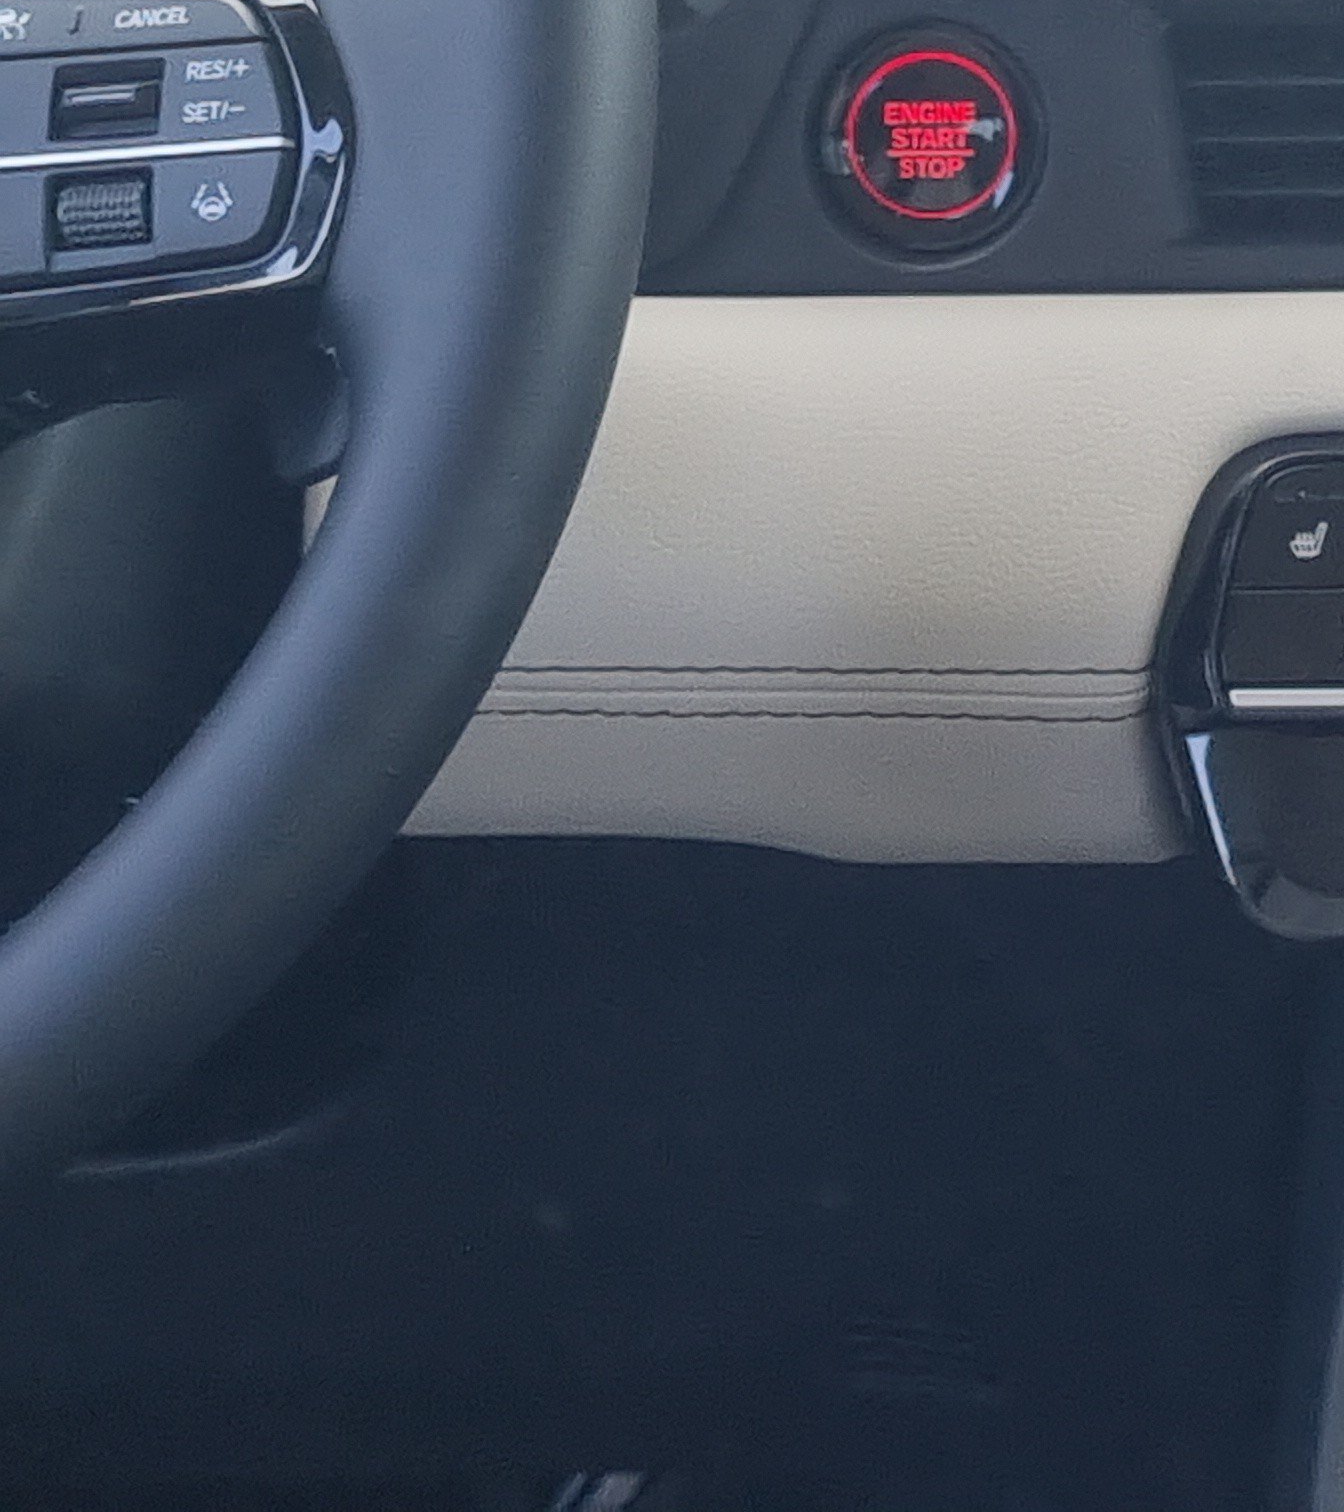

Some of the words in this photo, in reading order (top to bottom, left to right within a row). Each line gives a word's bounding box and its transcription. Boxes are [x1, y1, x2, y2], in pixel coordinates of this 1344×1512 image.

[114, 6, 190, 29] CANCEL
[185, 59, 250, 80] RES/+
[883, 102, 976, 125] ENGINE
[891, 127, 968, 148] START
[899, 157, 965, 178] STOP
